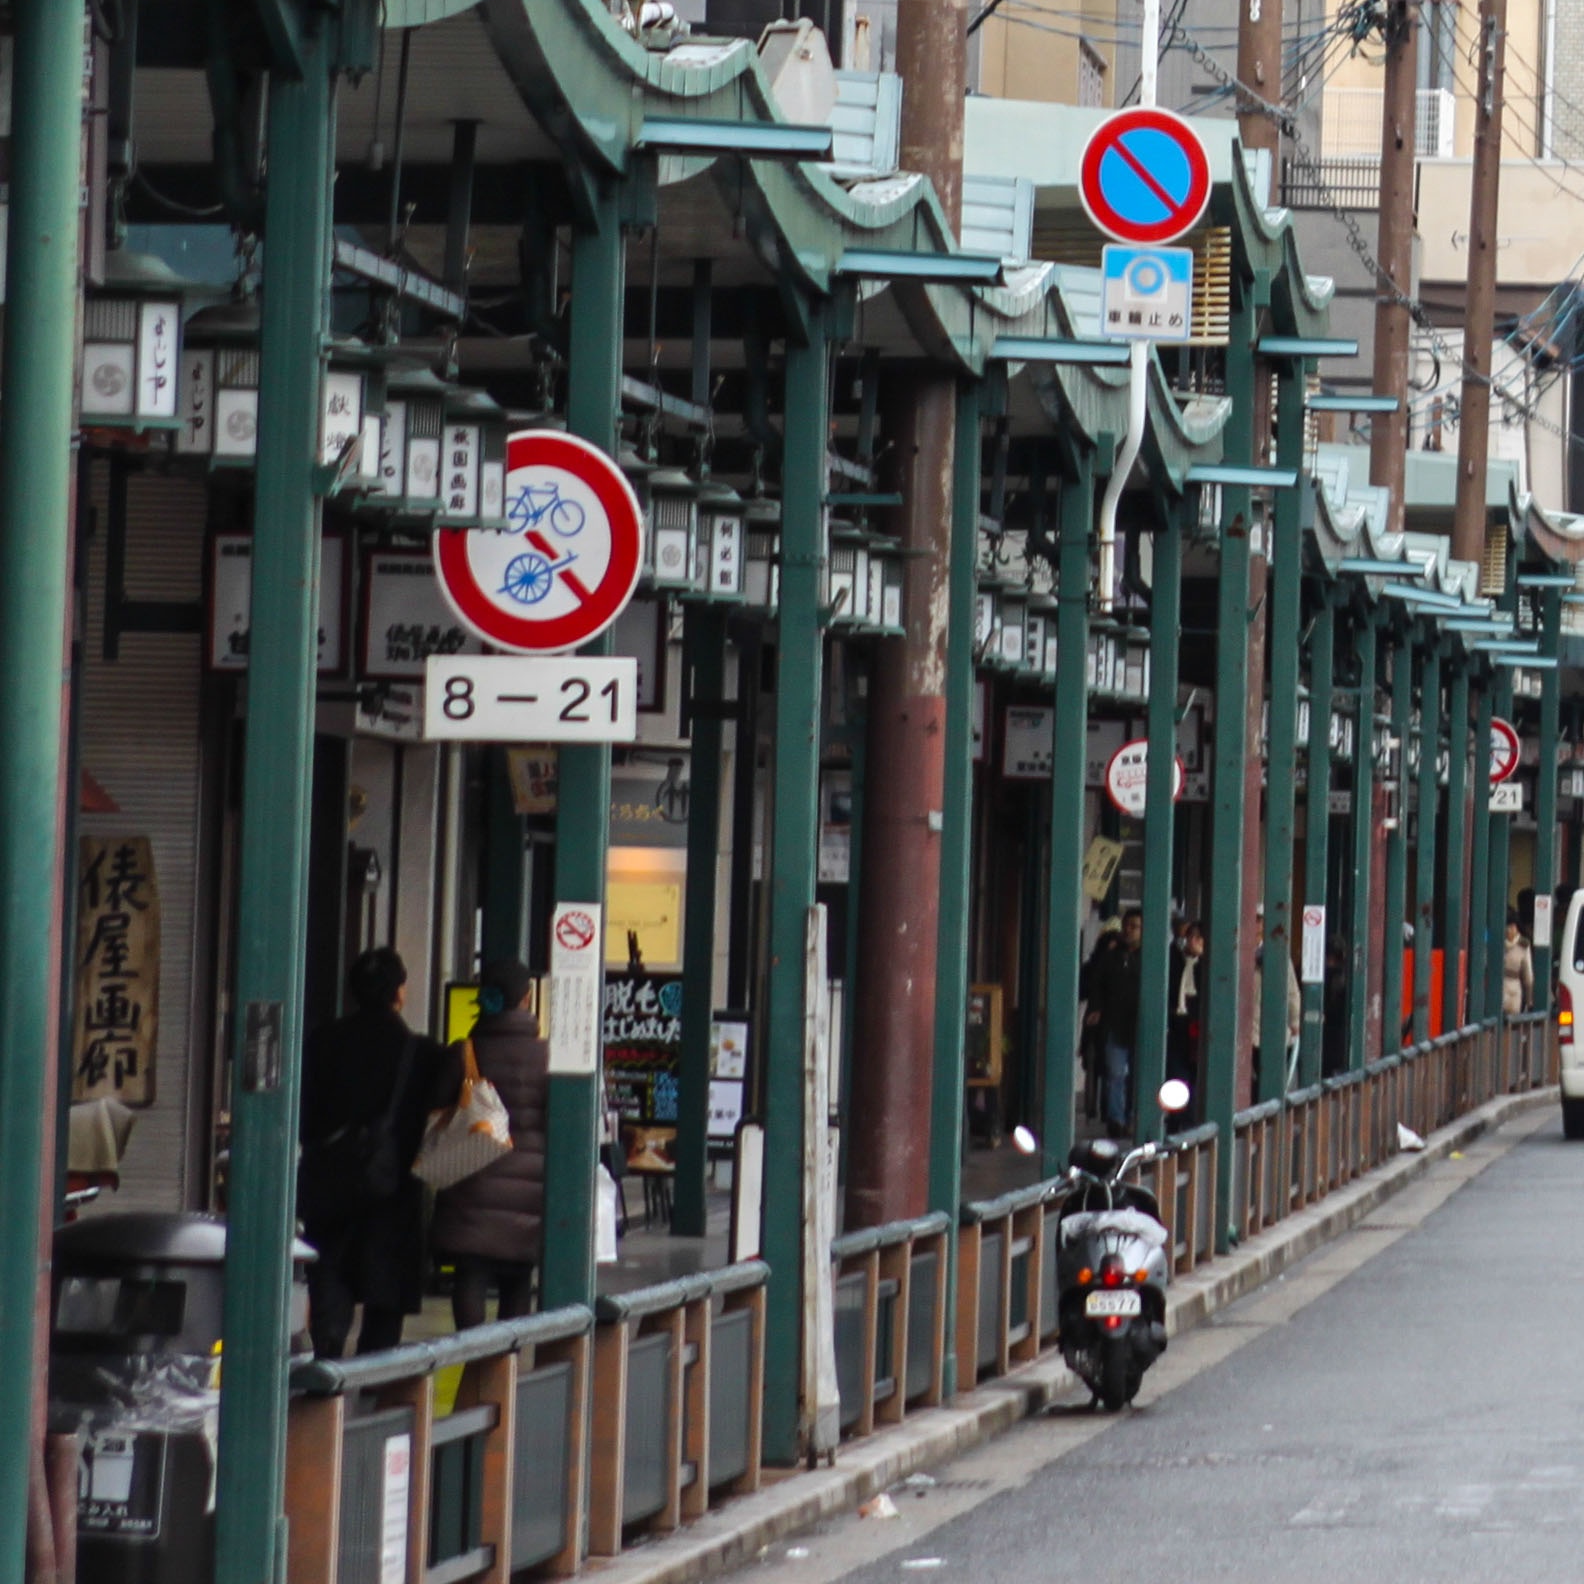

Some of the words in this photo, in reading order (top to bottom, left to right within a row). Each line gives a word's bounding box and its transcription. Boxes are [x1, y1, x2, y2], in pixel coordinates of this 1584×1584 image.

[1108, 310, 1183, 327] 車輪止め
[78, 844, 150, 1090] 俵屋画廊
